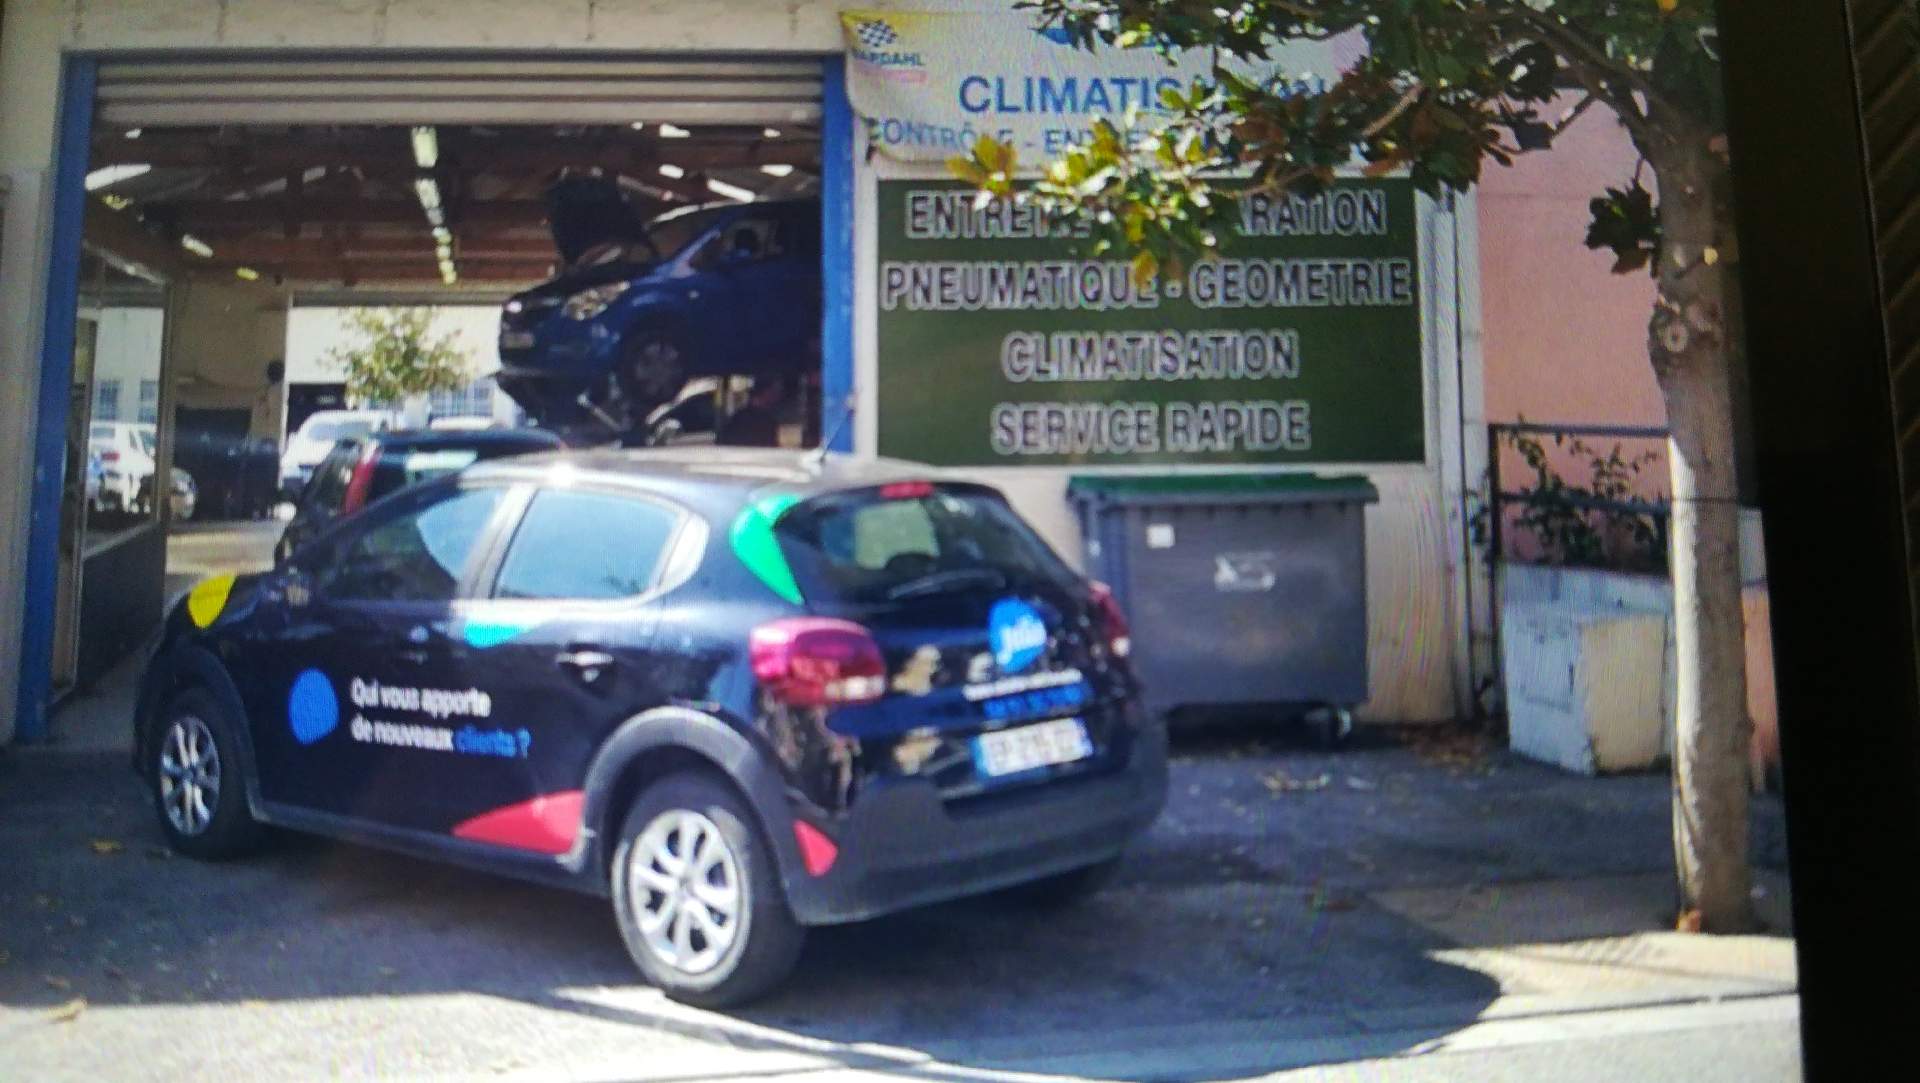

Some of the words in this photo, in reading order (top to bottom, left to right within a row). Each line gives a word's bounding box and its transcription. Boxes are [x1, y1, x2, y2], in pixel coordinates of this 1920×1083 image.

[1190, 257, 1413, 307] GEOMETRIE
[1001, 329, 1300, 382] CLIMATISATION
[990, 402, 1160, 455] SERVICE
[1164, 399, 1312, 452] RAPIDE
[380, 686, 420, 711] vous
[421, 687, 491, 719] apporte
[374, 721, 454, 751] nouveaux
